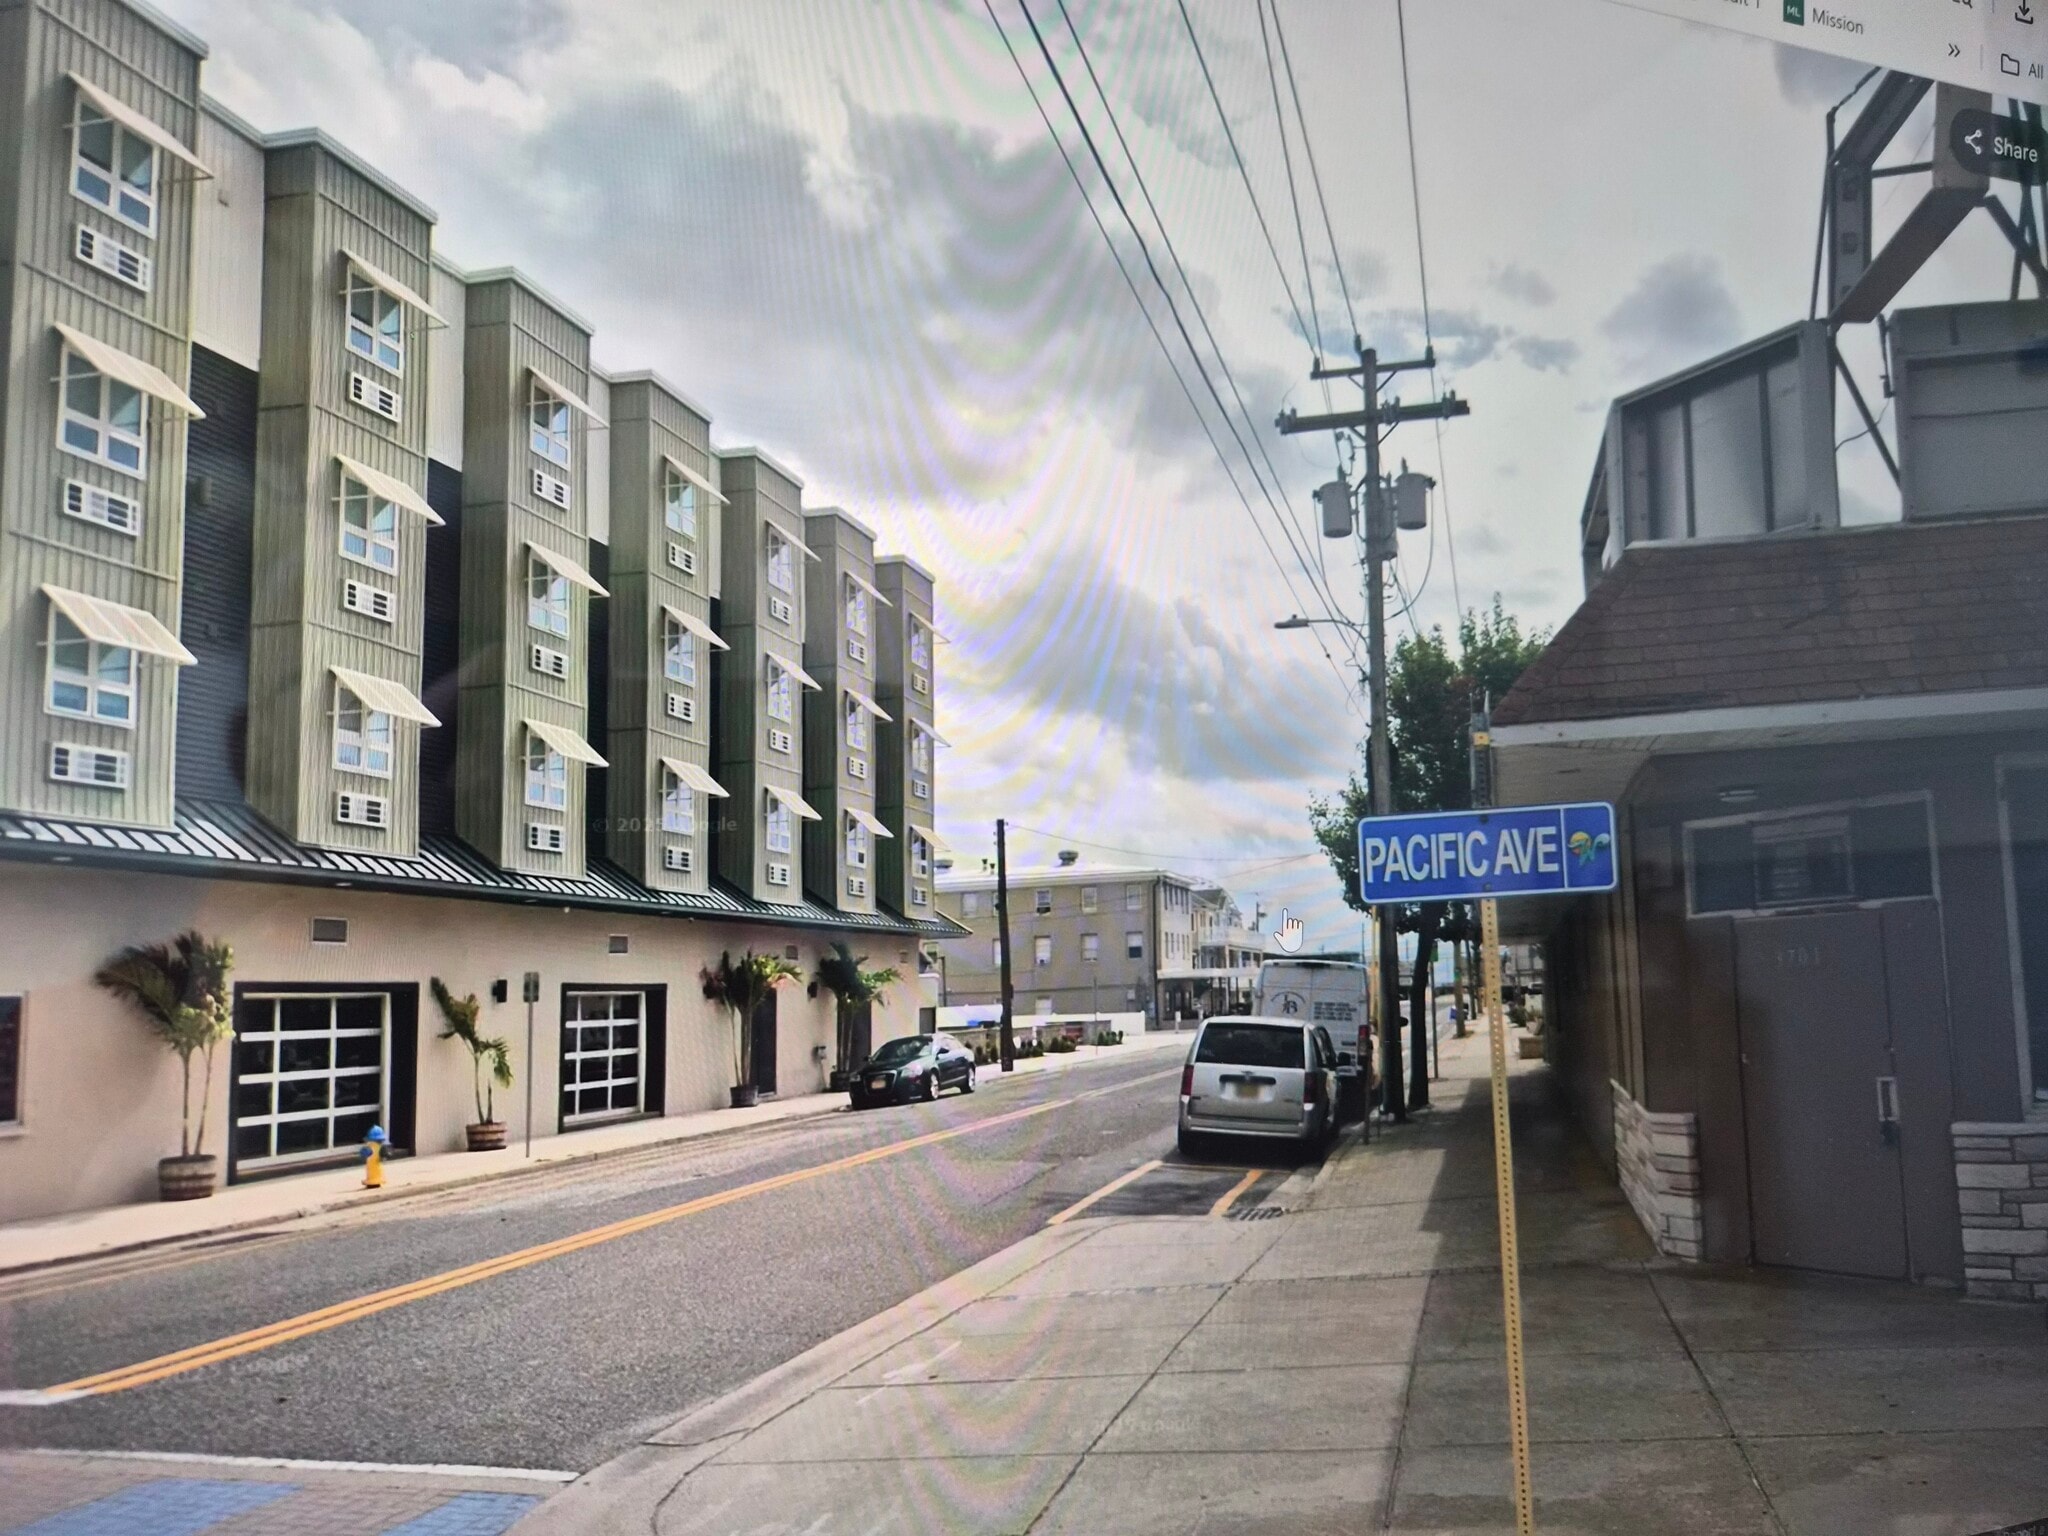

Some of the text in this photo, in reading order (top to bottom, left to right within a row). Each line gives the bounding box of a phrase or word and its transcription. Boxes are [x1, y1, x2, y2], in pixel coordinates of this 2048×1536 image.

[1812, 7, 1864, 35] Mission
[2028, 63, 2044, 80] All
[1993, 136, 2038, 163] Share
[1365, 826, 1560, 884] PACIFIC AVE
